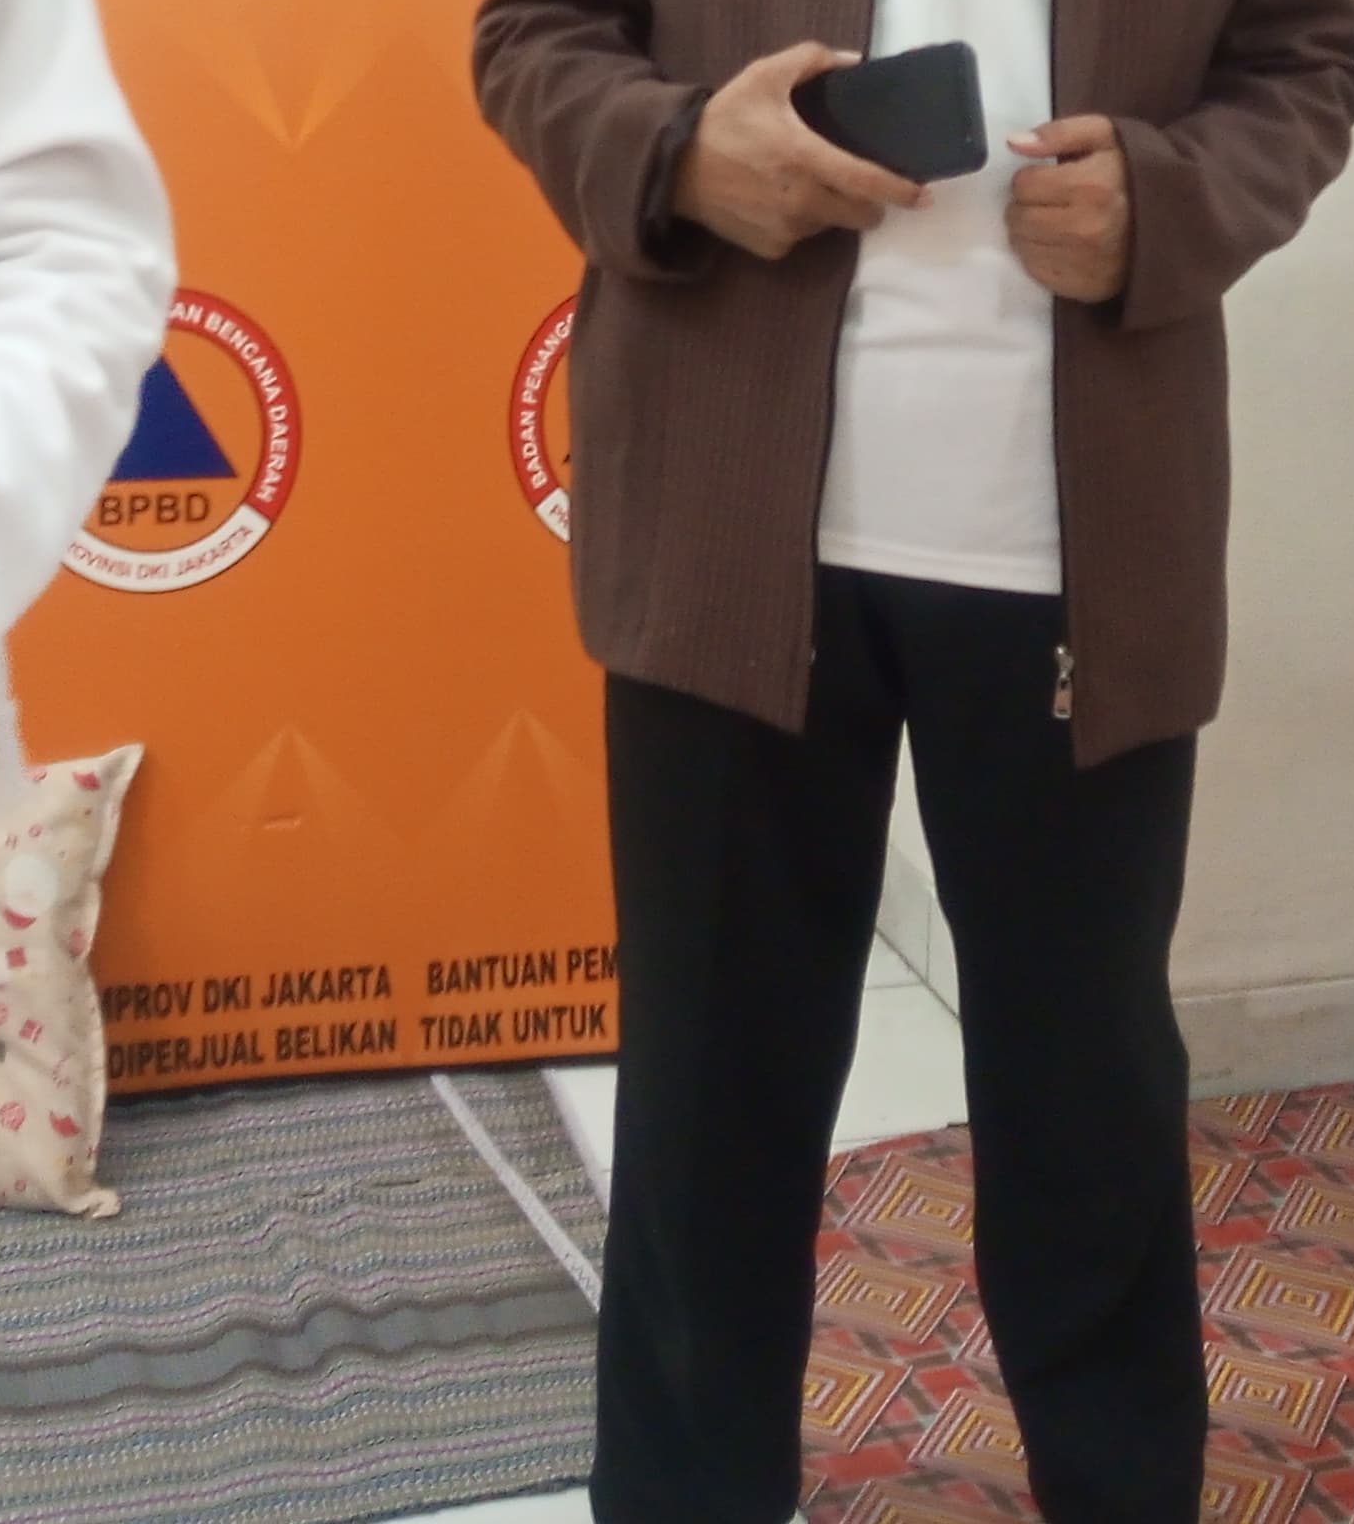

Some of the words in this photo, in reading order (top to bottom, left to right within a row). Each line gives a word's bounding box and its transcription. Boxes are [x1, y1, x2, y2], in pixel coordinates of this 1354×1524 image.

[204, 310, 283, 403] BENCANA
[255, 404, 290, 504] DAERAH
[519, 409, 547, 489] BADAN
[99, 492, 211, 526] BPBD
[202, 975, 251, 1015] DKI
[261, 963, 391, 1009] JAKARTA
[426, 952, 557, 996] BANTUAN
[108, 1029, 265, 1080] DIPERJUAL
[276, 1019, 397, 1062] BELIKAN
[420, 1011, 502, 1051] TIDAK
[513, 1003, 607, 1044] UNTUK
